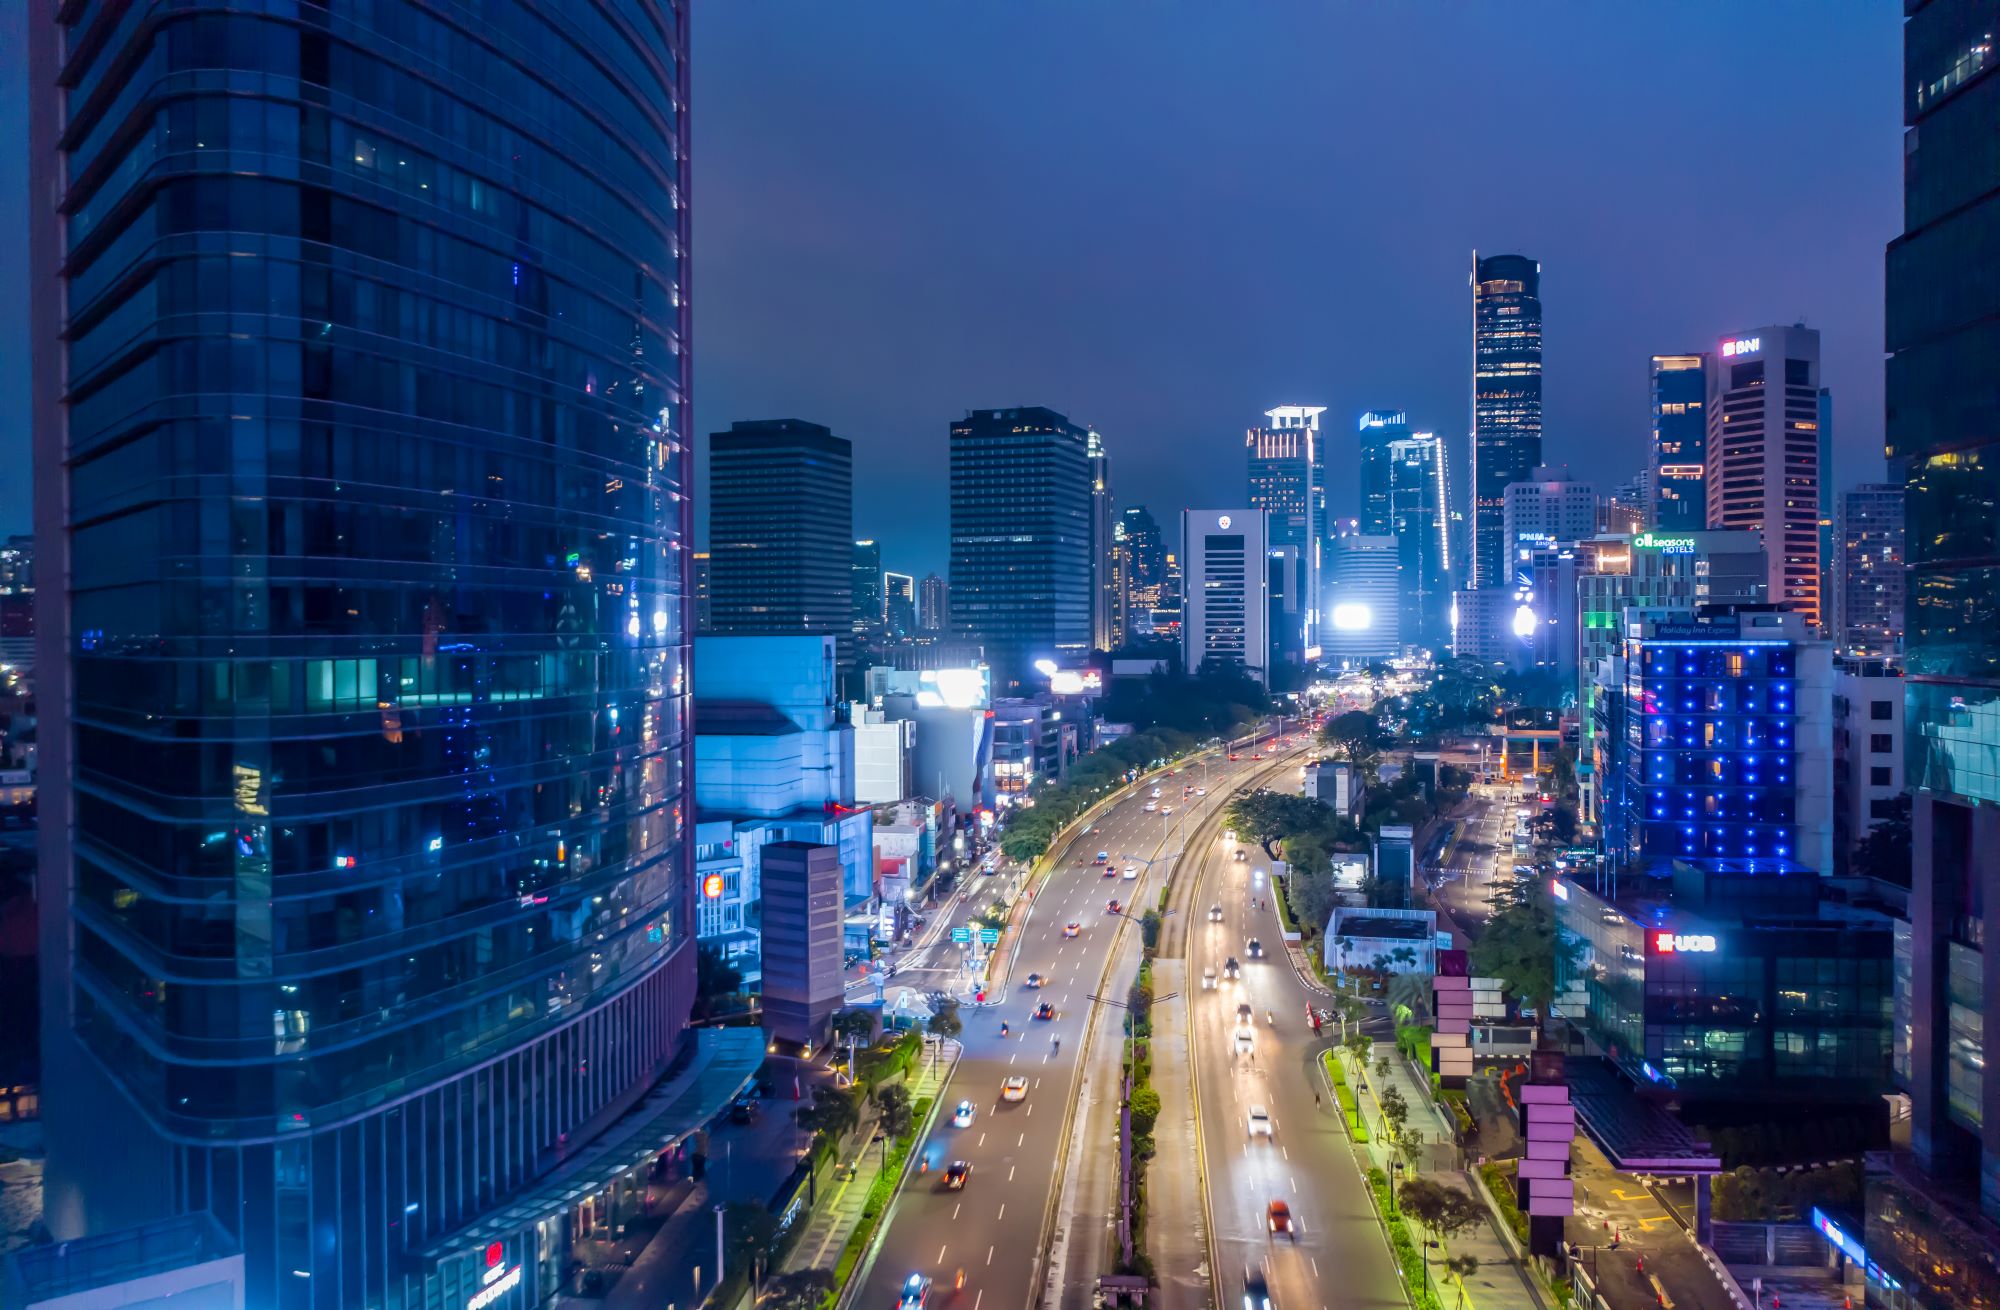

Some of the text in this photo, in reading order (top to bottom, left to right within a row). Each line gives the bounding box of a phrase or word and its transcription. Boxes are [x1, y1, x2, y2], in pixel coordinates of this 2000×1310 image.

[1736, 338, 1760, 354] BNI
[1653, 538, 1695, 547] seasons
[1662, 546, 1695, 554] HOTELS
[1660, 625, 1692, 635] Holiday
[1692, 625, 1706, 633] Inn
[1675, 935, 1716, 952] UOB
